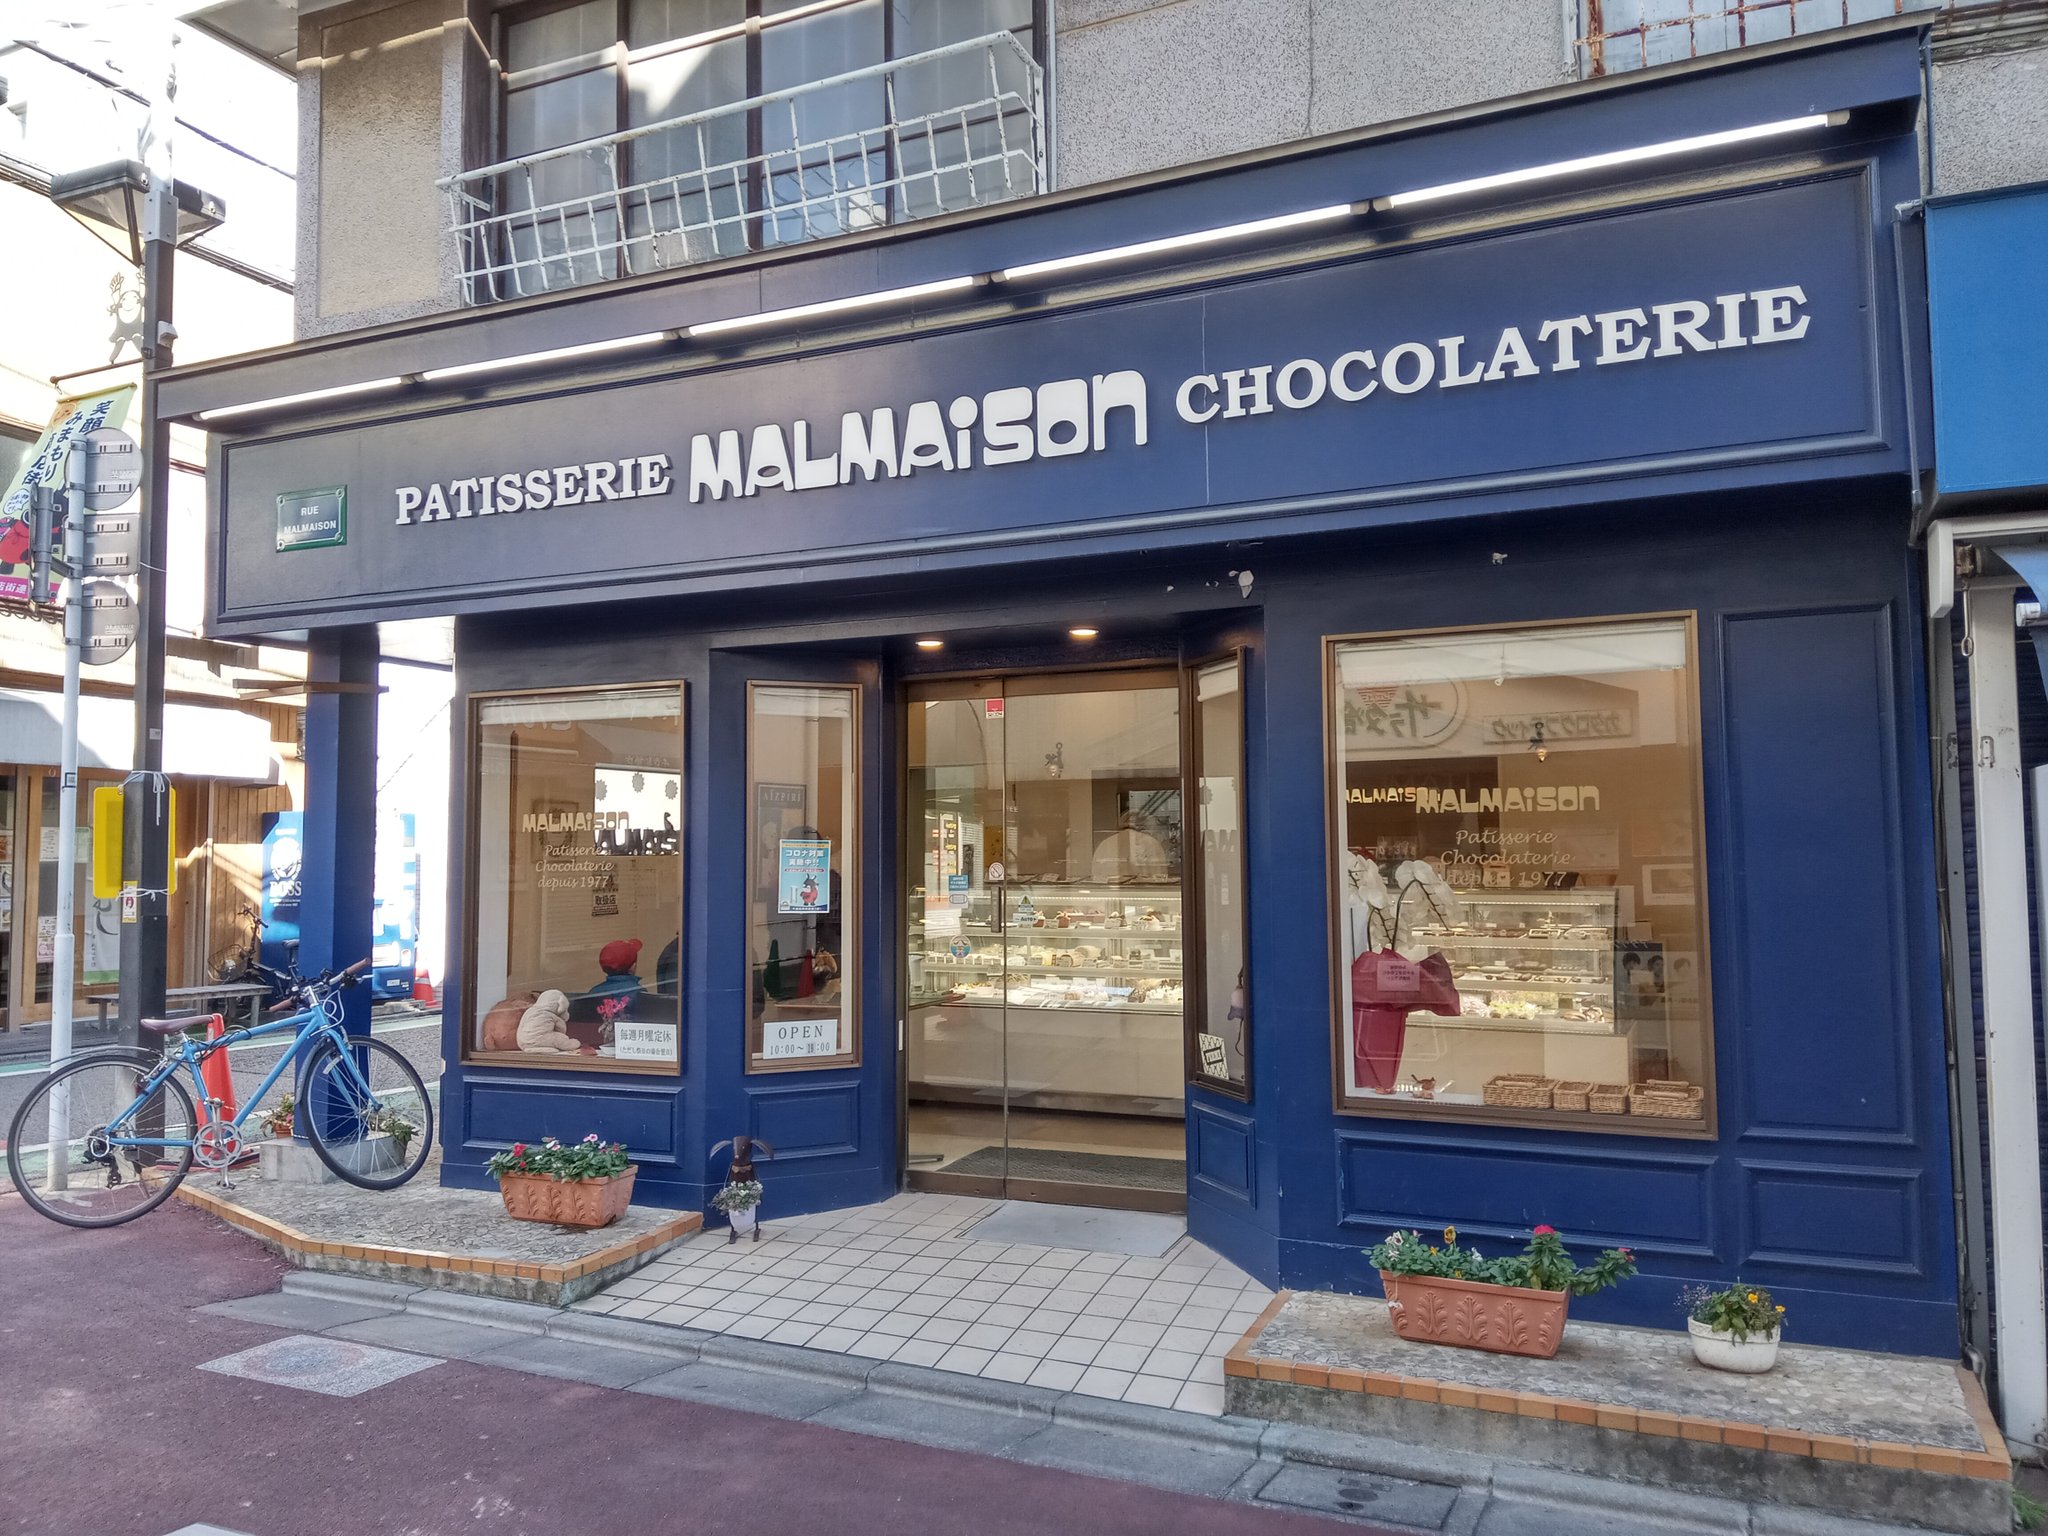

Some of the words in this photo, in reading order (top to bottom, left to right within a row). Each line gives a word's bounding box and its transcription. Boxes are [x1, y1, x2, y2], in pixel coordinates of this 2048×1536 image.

[395, 454, 671, 525] PATISSERIE
[1175, 285, 1812, 424] CHOCOLATERIE
[45, 411, 83, 482] みまもり
[300, 505, 319, 516] RUE
[283, 520, 337, 534] MALMAISON
[1455, 829, 1558, 846] Patisserie
[545, 844, 605, 856] Patisserie
[1441, 849, 1573, 866] Chocolaterie
[535, 860, 615, 872] Chocolaterie
[538, 876, 579, 891] depuis
[581, 875, 609, 889] 1977
[1518, 871, 1569, 888] 1977
[620, 1029, 672, 1043] 毎週月曜定休
[778, 1024, 824, 1040] OPEN
